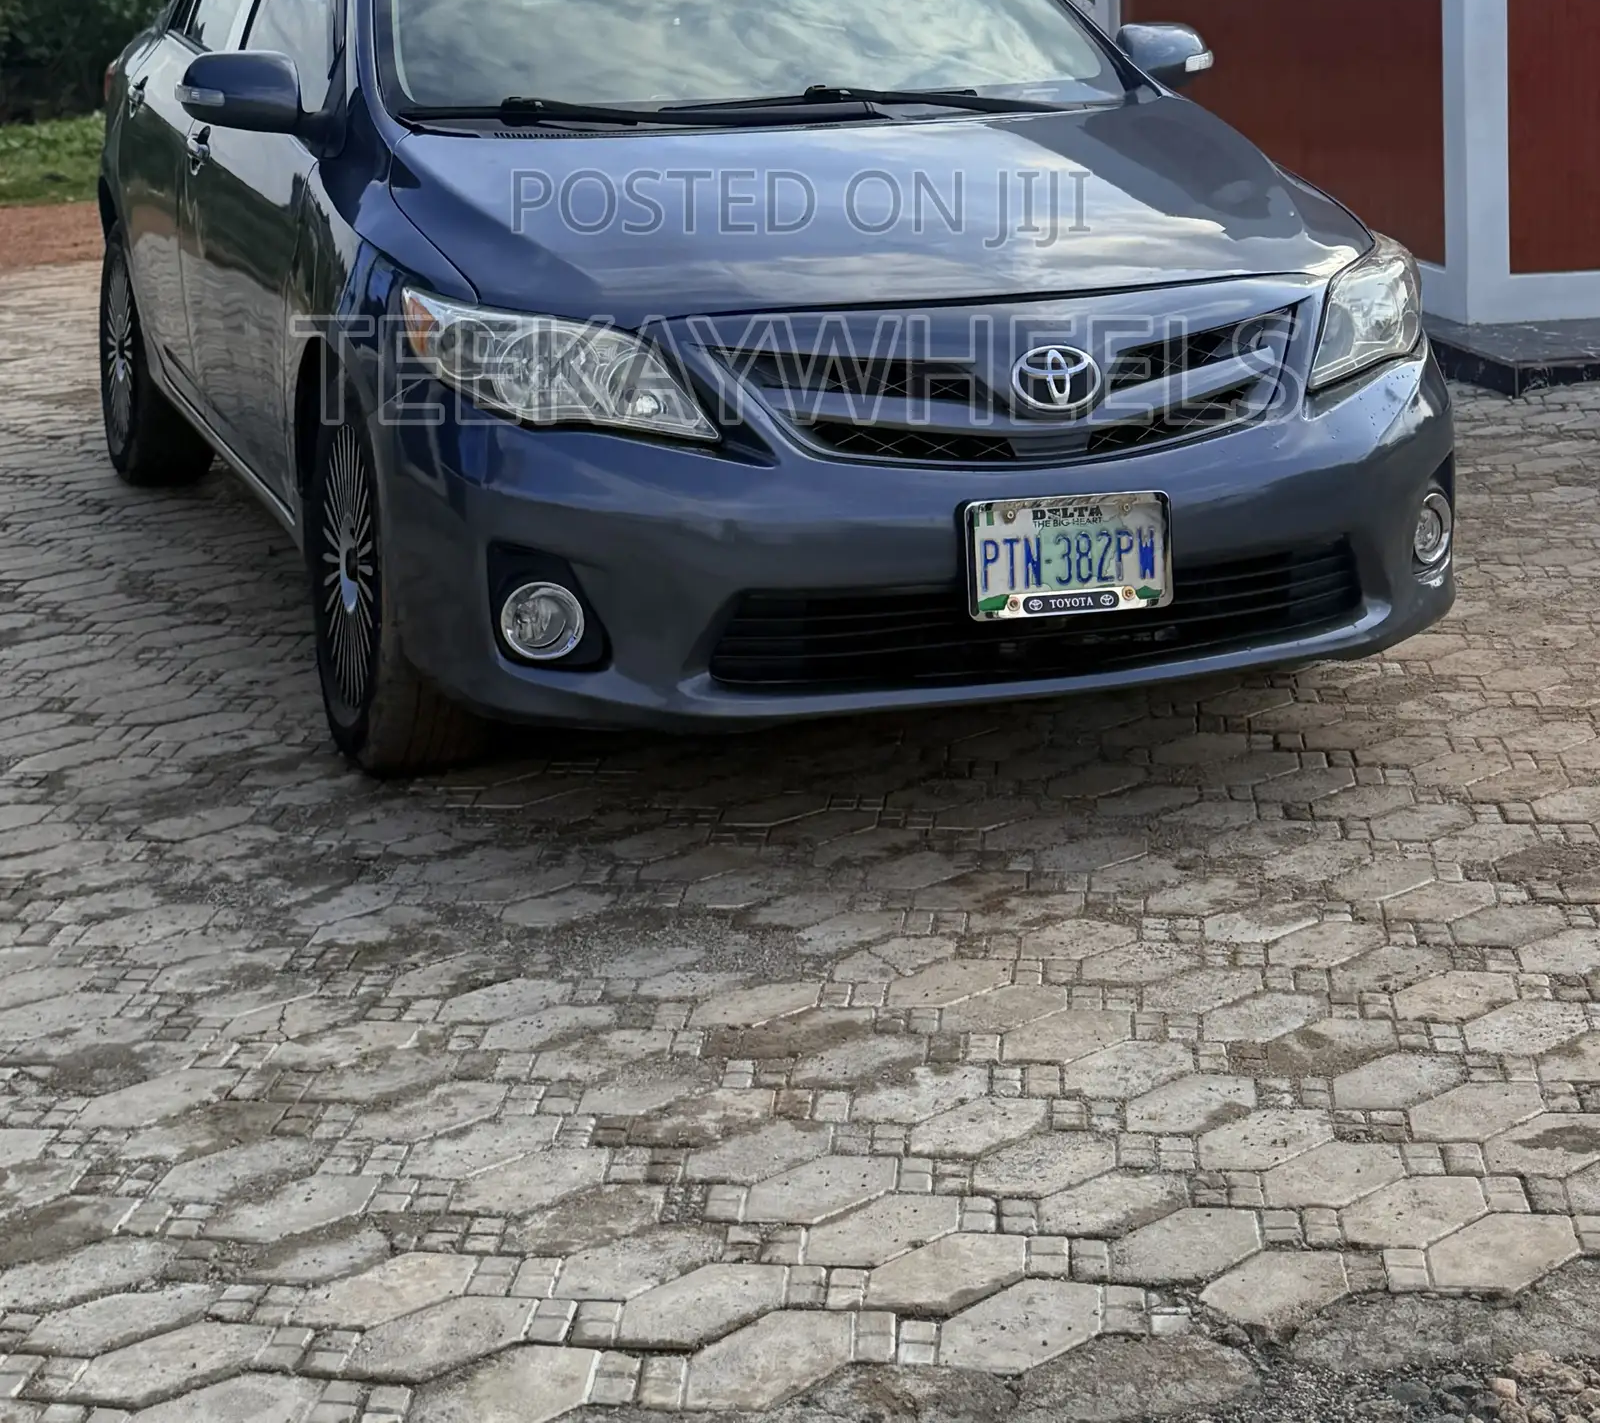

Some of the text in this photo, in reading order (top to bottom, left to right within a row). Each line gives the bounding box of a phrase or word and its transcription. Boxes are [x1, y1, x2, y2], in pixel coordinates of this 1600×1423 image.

[1032, 505, 1103, 521] DELTA
[1033, 520, 1051, 528] THE
[1053, 518, 1071, 527] BIG
[1049, 596, 1094, 609] TOYOTA
